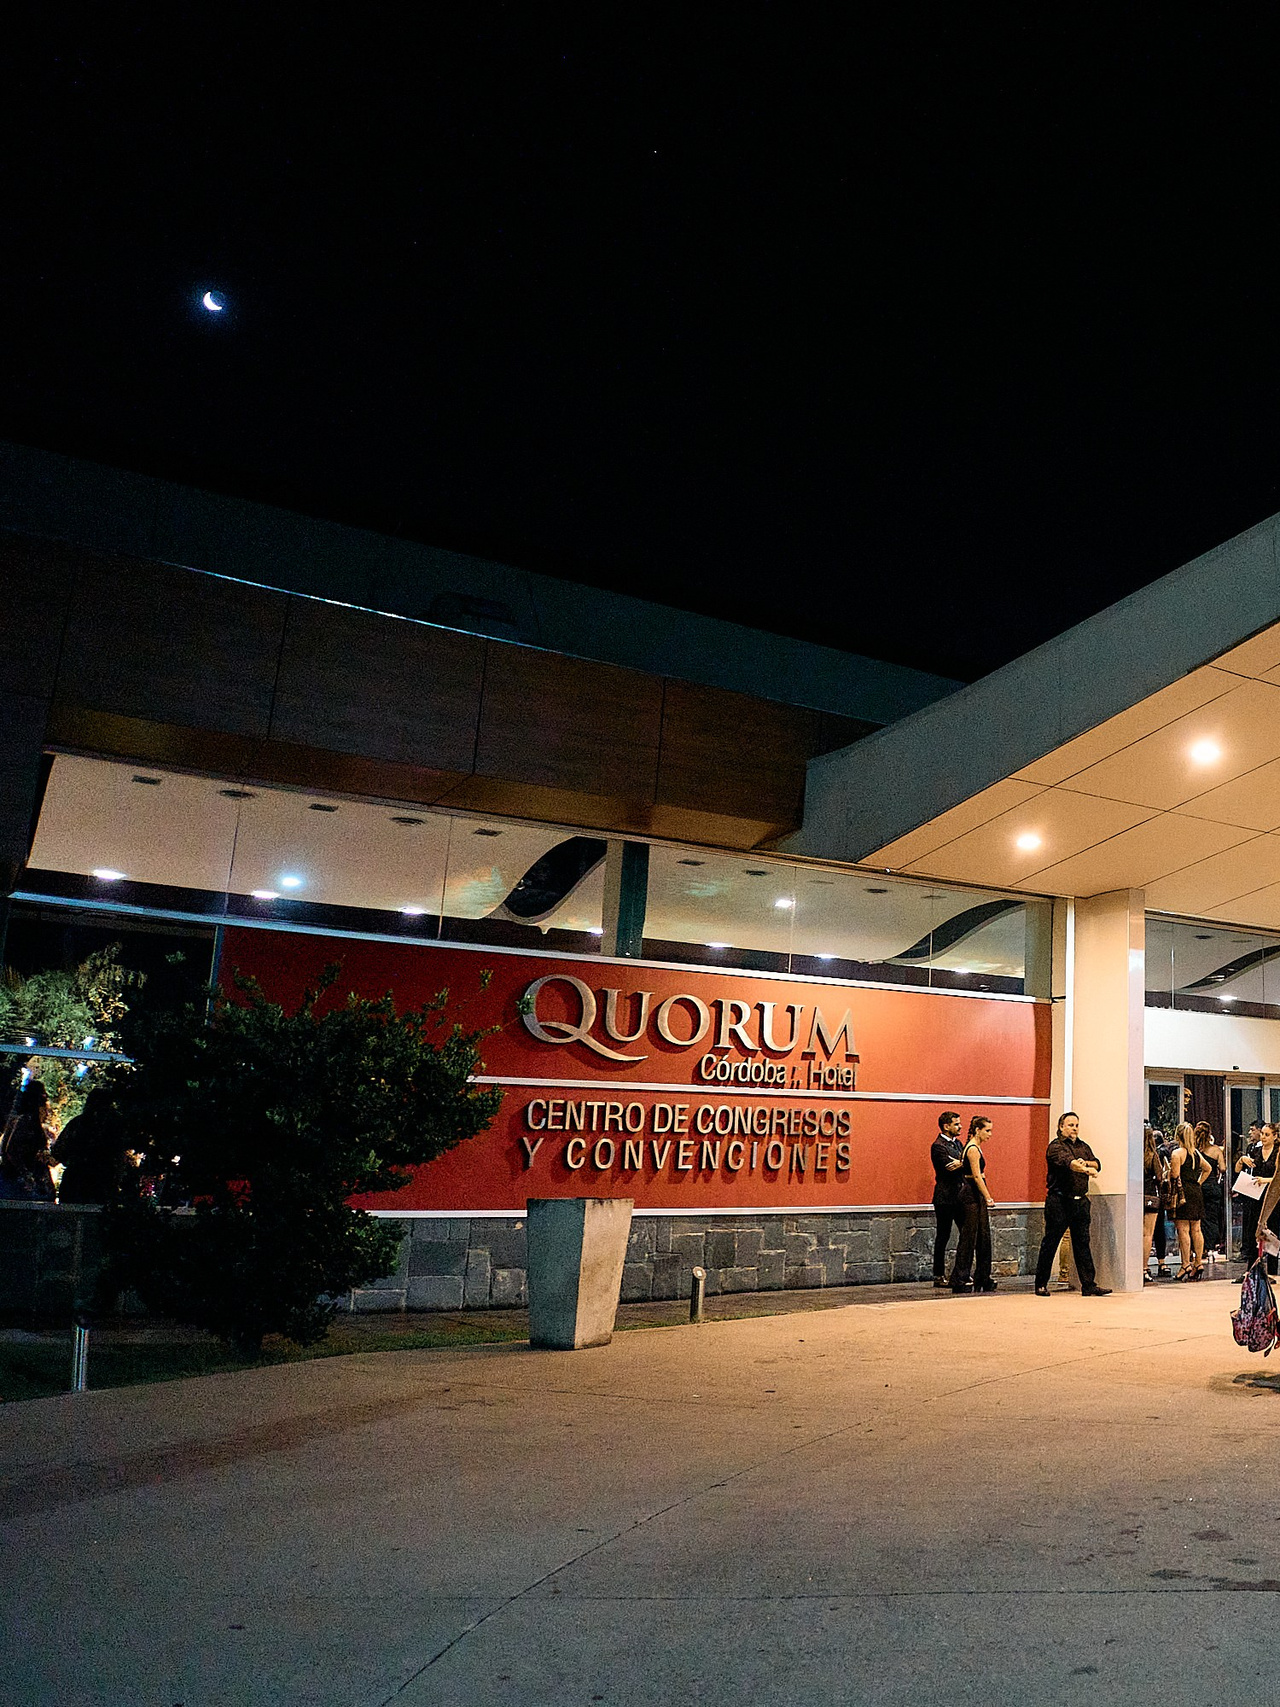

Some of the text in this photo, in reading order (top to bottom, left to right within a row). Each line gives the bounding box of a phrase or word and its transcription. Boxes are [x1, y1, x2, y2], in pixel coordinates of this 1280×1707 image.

[523, 974, 860, 1062] QUORUM
[701, 1053, 787, 1084] Córdoba
[809, 1060, 857, 1087] Hotel
[527, 1098, 852, 1136] CENTRO DE CONGRESOS
[522, 1136, 852, 1171] Y CONVENCIONES
